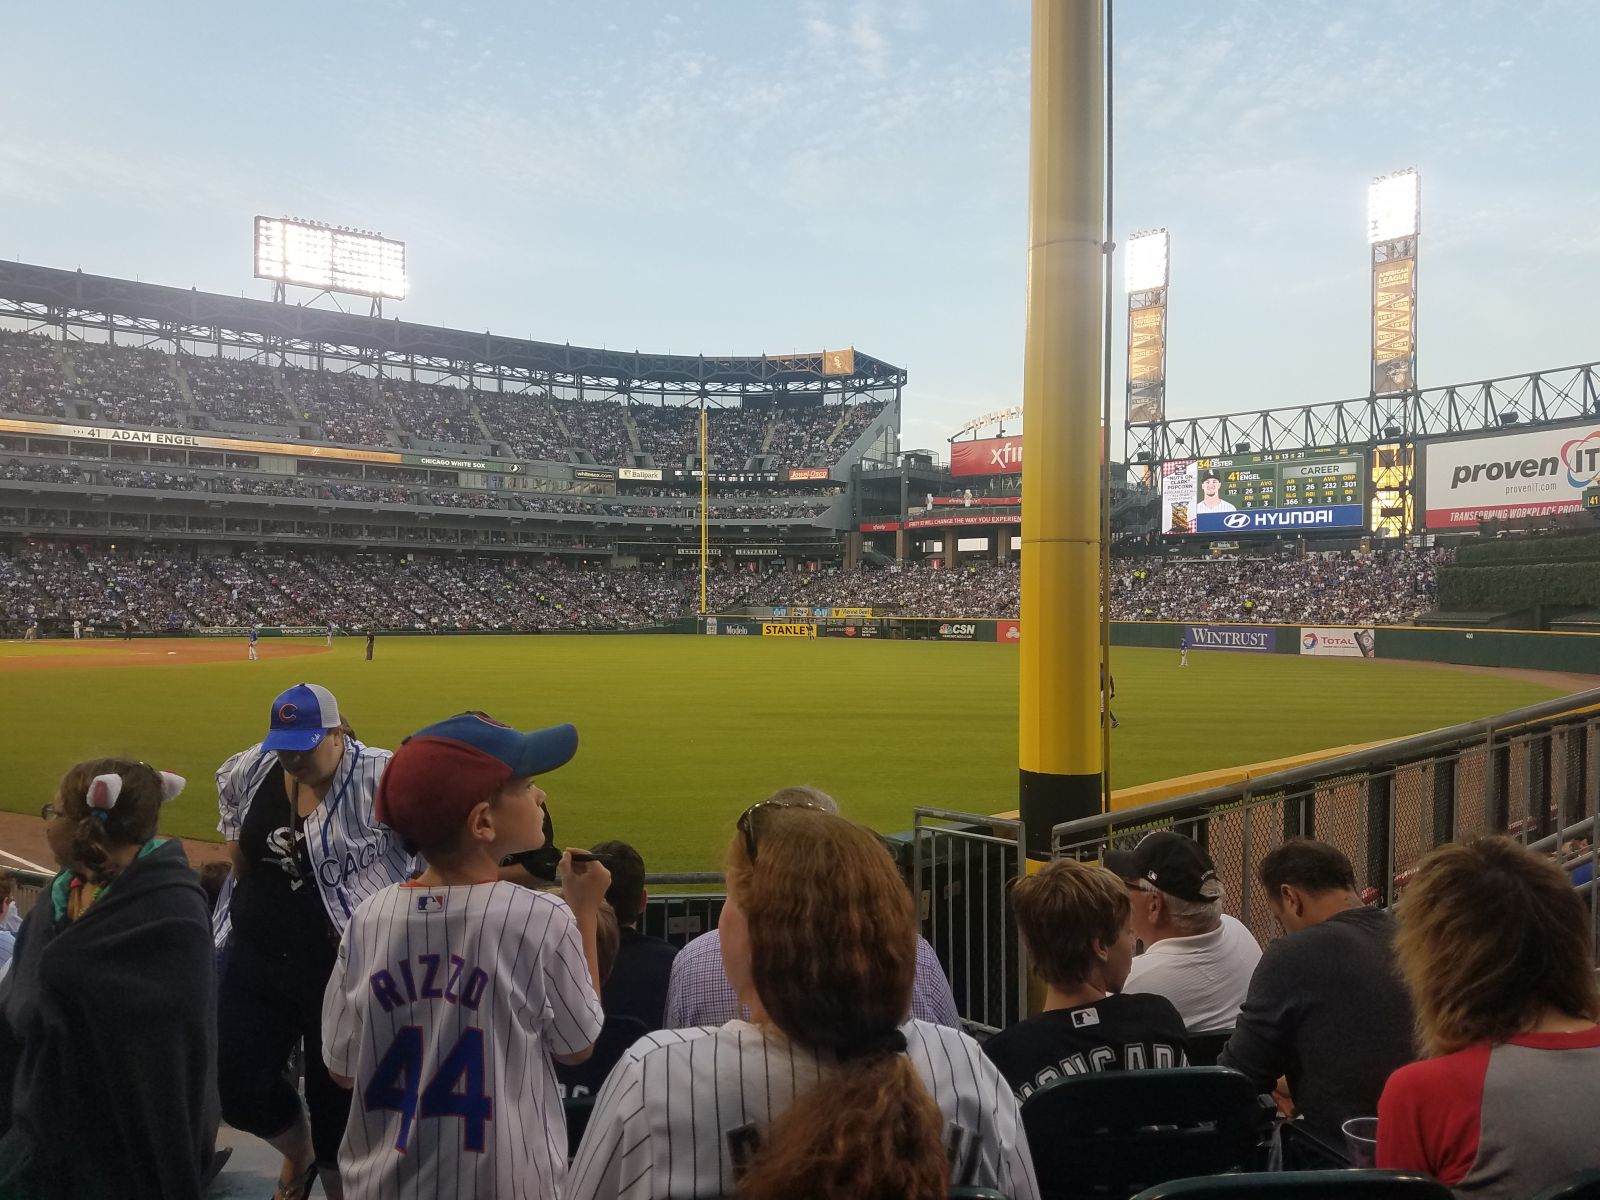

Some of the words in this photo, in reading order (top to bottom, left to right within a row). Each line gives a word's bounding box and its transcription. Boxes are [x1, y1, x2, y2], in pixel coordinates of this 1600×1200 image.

[1379, 272, 1408, 284] LEAGUE
[87, 429, 100, 438] 41
[111, 430, 151, 442] ADAM
[156, 434, 199, 446] ENGEL
[421, 458, 450, 466] CHICAGO
[1198, 460, 1210, 469] 34
[1575, 448, 1600, 473] IT
[632, 471, 659, 479] Ballpark
[1228, 471, 1240, 481] 41
[1300, 466, 1340, 475] CAREER
[1451, 457, 1559, 489] proven
[1505, 482, 1557, 495] provenIT.com
[1590, 496, 1598, 505] 41
[1255, 509, 1333, 526] HYUNDAI
[726, 624, 748, 635] Modelo
[952, 624, 976, 635] CSN
[1191, 628, 1268, 646] WINTRUST
[1320, 636, 1355, 645] TOTAL
[278, 703, 298, 721] C
[370, 953, 489, 1013] RIZZO
[364, 1025, 493, 1155] 44
